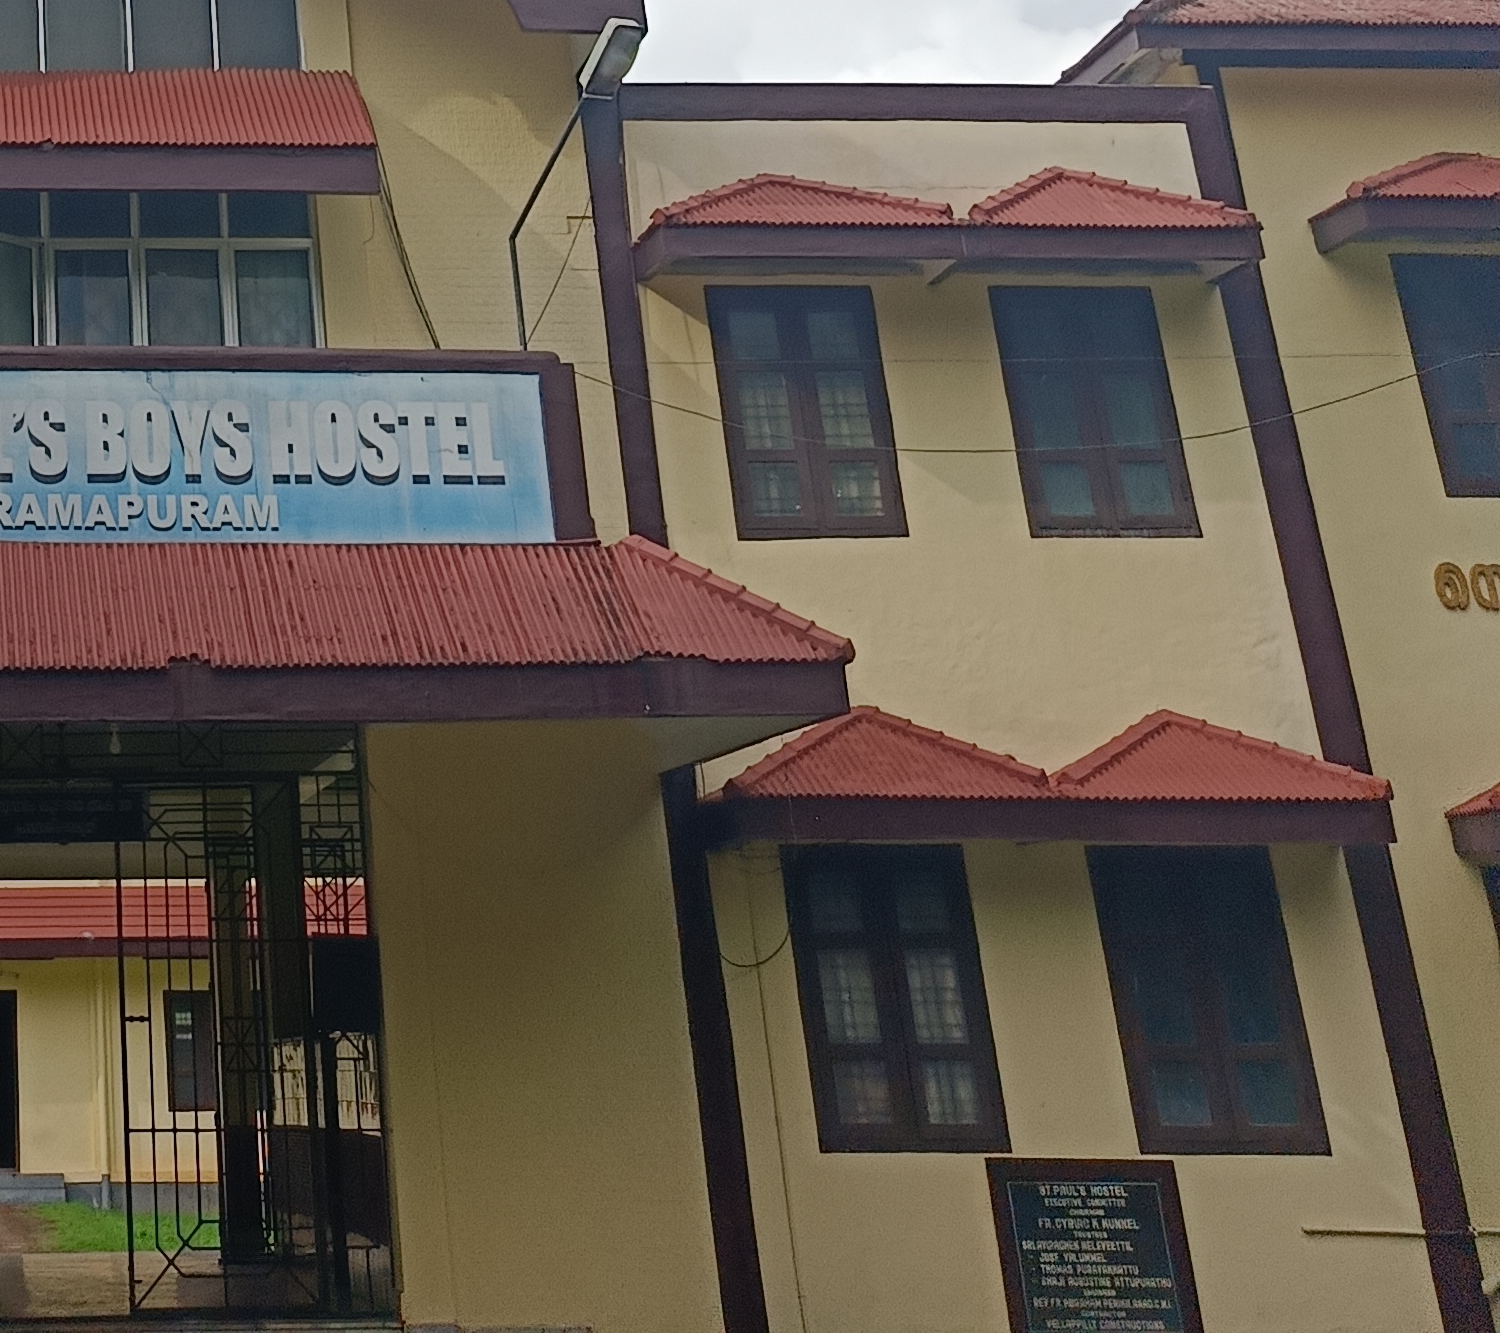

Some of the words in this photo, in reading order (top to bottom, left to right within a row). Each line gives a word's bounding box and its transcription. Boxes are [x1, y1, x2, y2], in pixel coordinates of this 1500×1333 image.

[84, 399, 254, 484] BOYS
[268, 400, 506, 485] HOSTEL
[1090, 1186, 1129, 1197] HOSTEL
